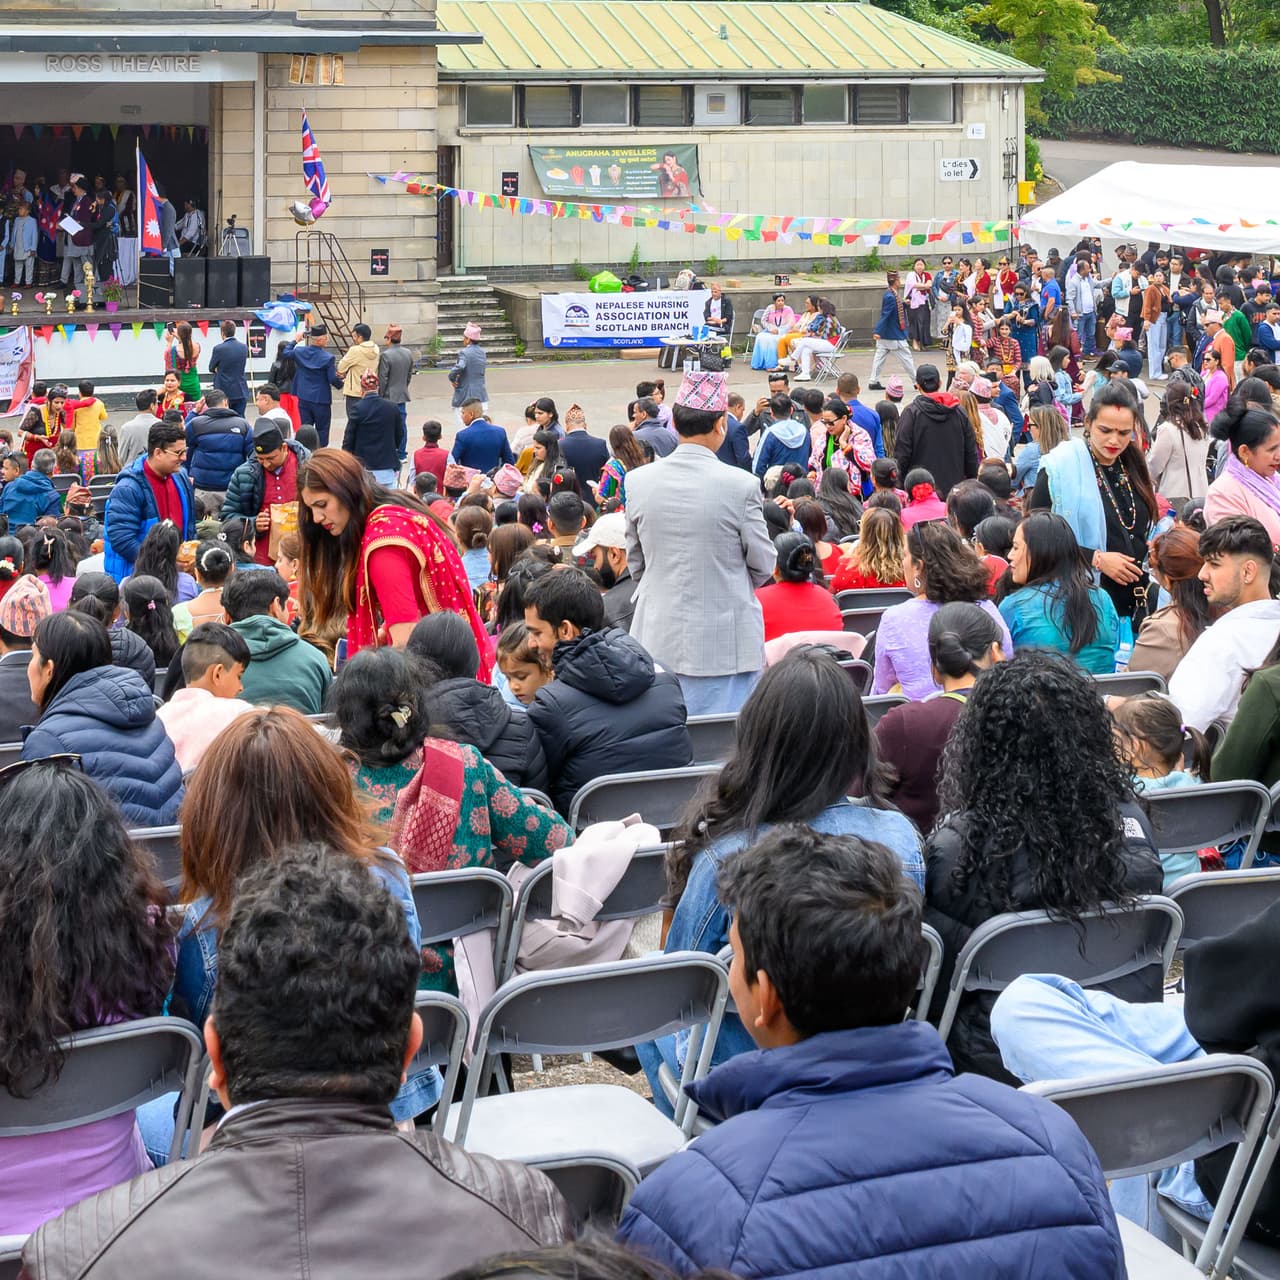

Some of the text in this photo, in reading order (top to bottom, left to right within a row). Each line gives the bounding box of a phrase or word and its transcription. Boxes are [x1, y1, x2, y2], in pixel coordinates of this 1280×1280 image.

[46, 55, 200, 73] ROSS THEATRE
[565, 148, 657, 157] ANUGRAHA JEWELLERS
[942, 160, 968, 168] Ldies
[943, 169, 963, 177] olet
[595, 301, 689, 310] NEPALESE NURSING
[595, 311, 688, 321] ASSOCIATION UK
[595, 322, 689, 332] SCOTLAND BRANCH
